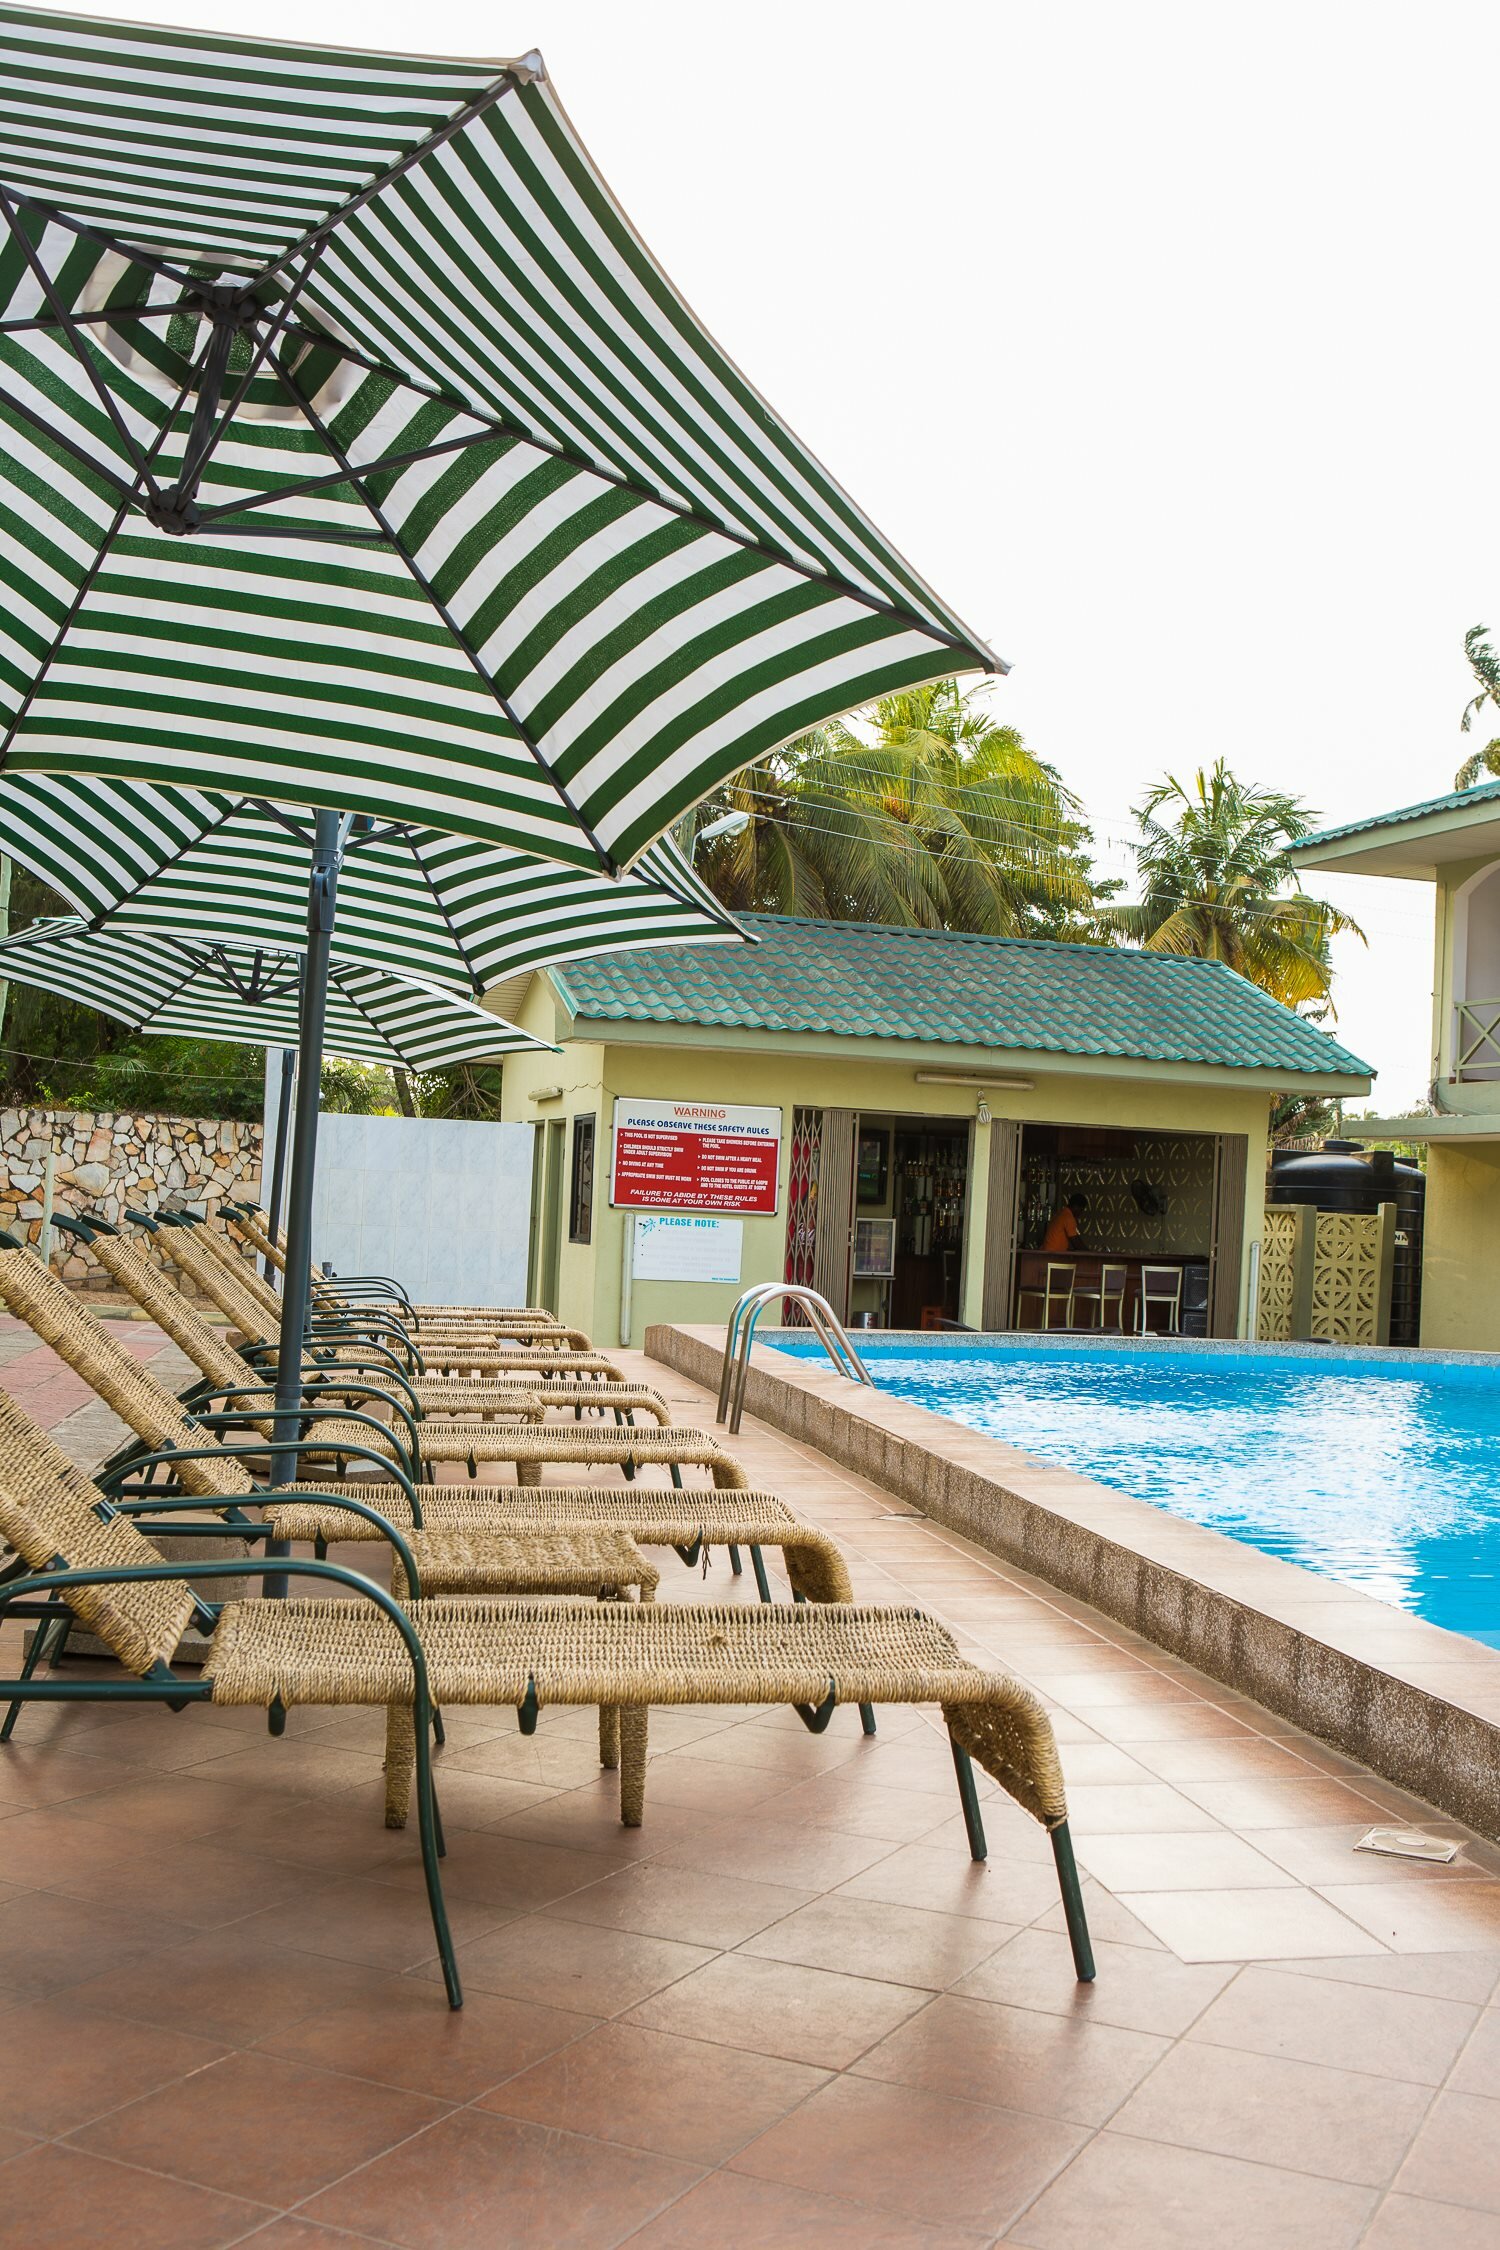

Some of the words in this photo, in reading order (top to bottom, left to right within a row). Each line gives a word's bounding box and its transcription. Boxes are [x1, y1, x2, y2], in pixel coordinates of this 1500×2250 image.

[674, 1107, 726, 1118] WARNING
[628, 1118, 655, 1126] PLEASE
[657, 1121, 692, 1129] OBSERVE
[718, 1125, 744, 1133] SAFETY
[660, 1218, 692, 1226] PLEASE
[695, 1219, 719, 1228] NOTE:
